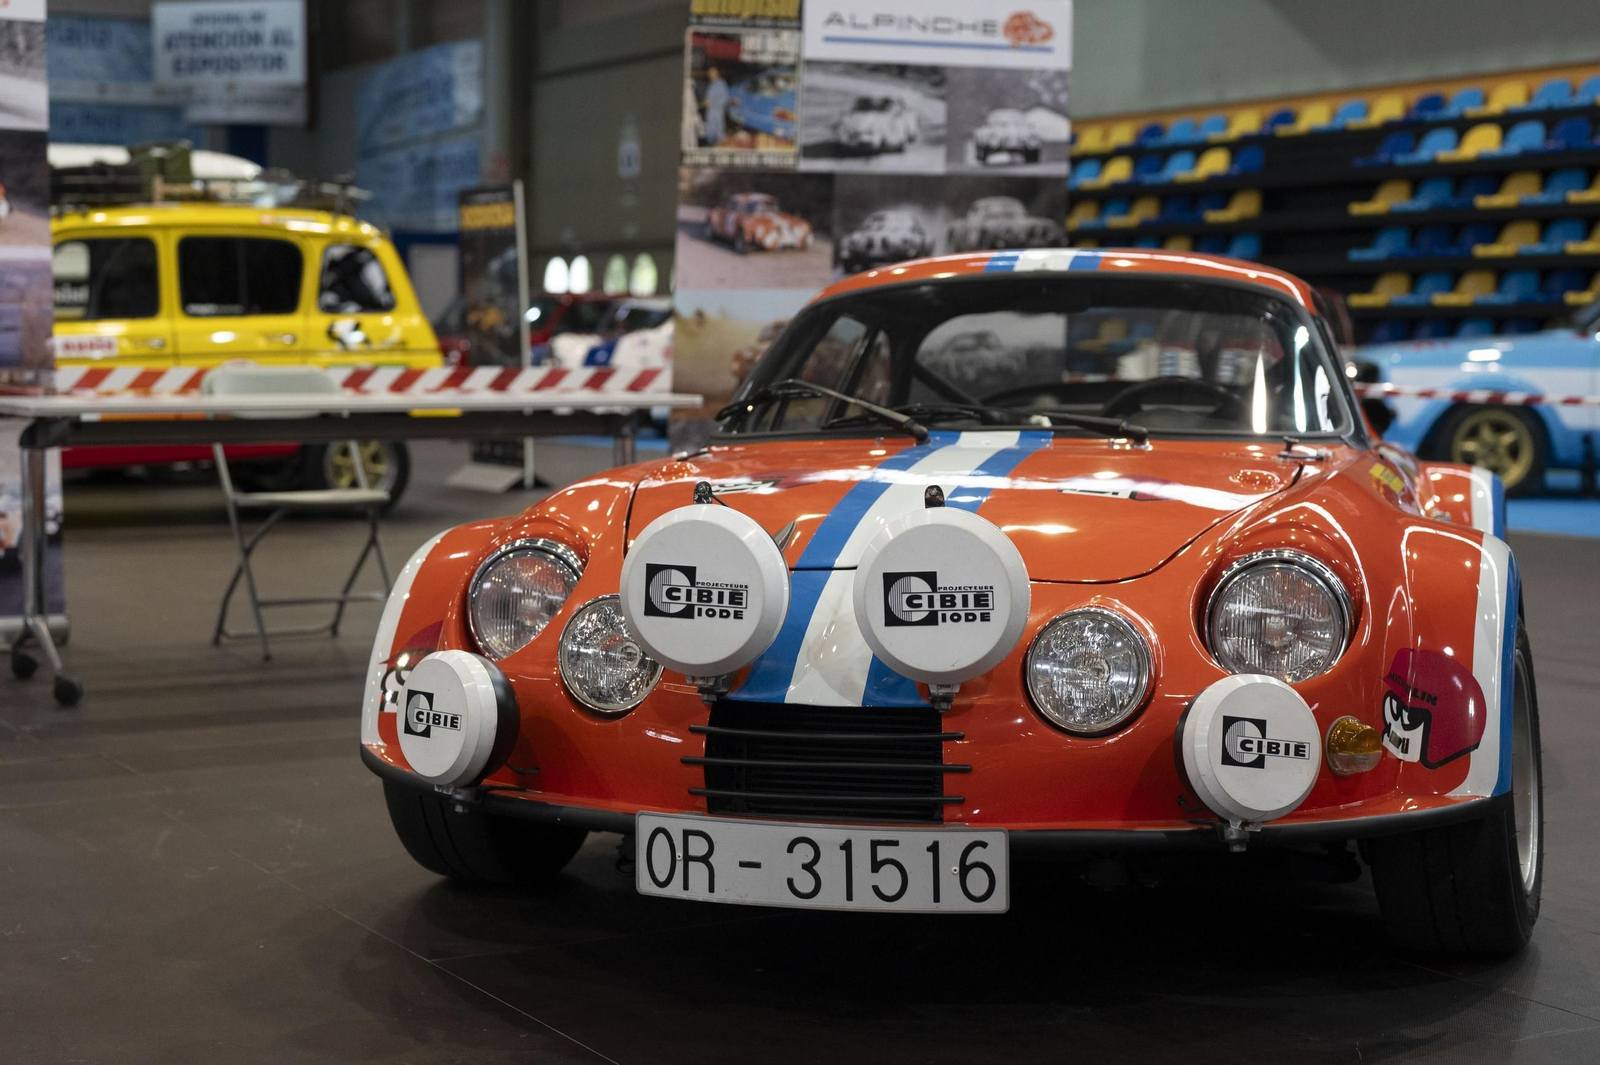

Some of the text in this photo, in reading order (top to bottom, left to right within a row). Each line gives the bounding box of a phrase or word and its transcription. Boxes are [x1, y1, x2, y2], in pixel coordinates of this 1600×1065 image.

[823, 11, 998, 36] ALPINCHE
[696, 581, 749, 589] PROJECTEURS
[697, 607, 744, 620] IODE
[941, 612, 991, 623] IODE
[646, 826, 716, 894] OR
[786, 836, 996, 903] 31516
